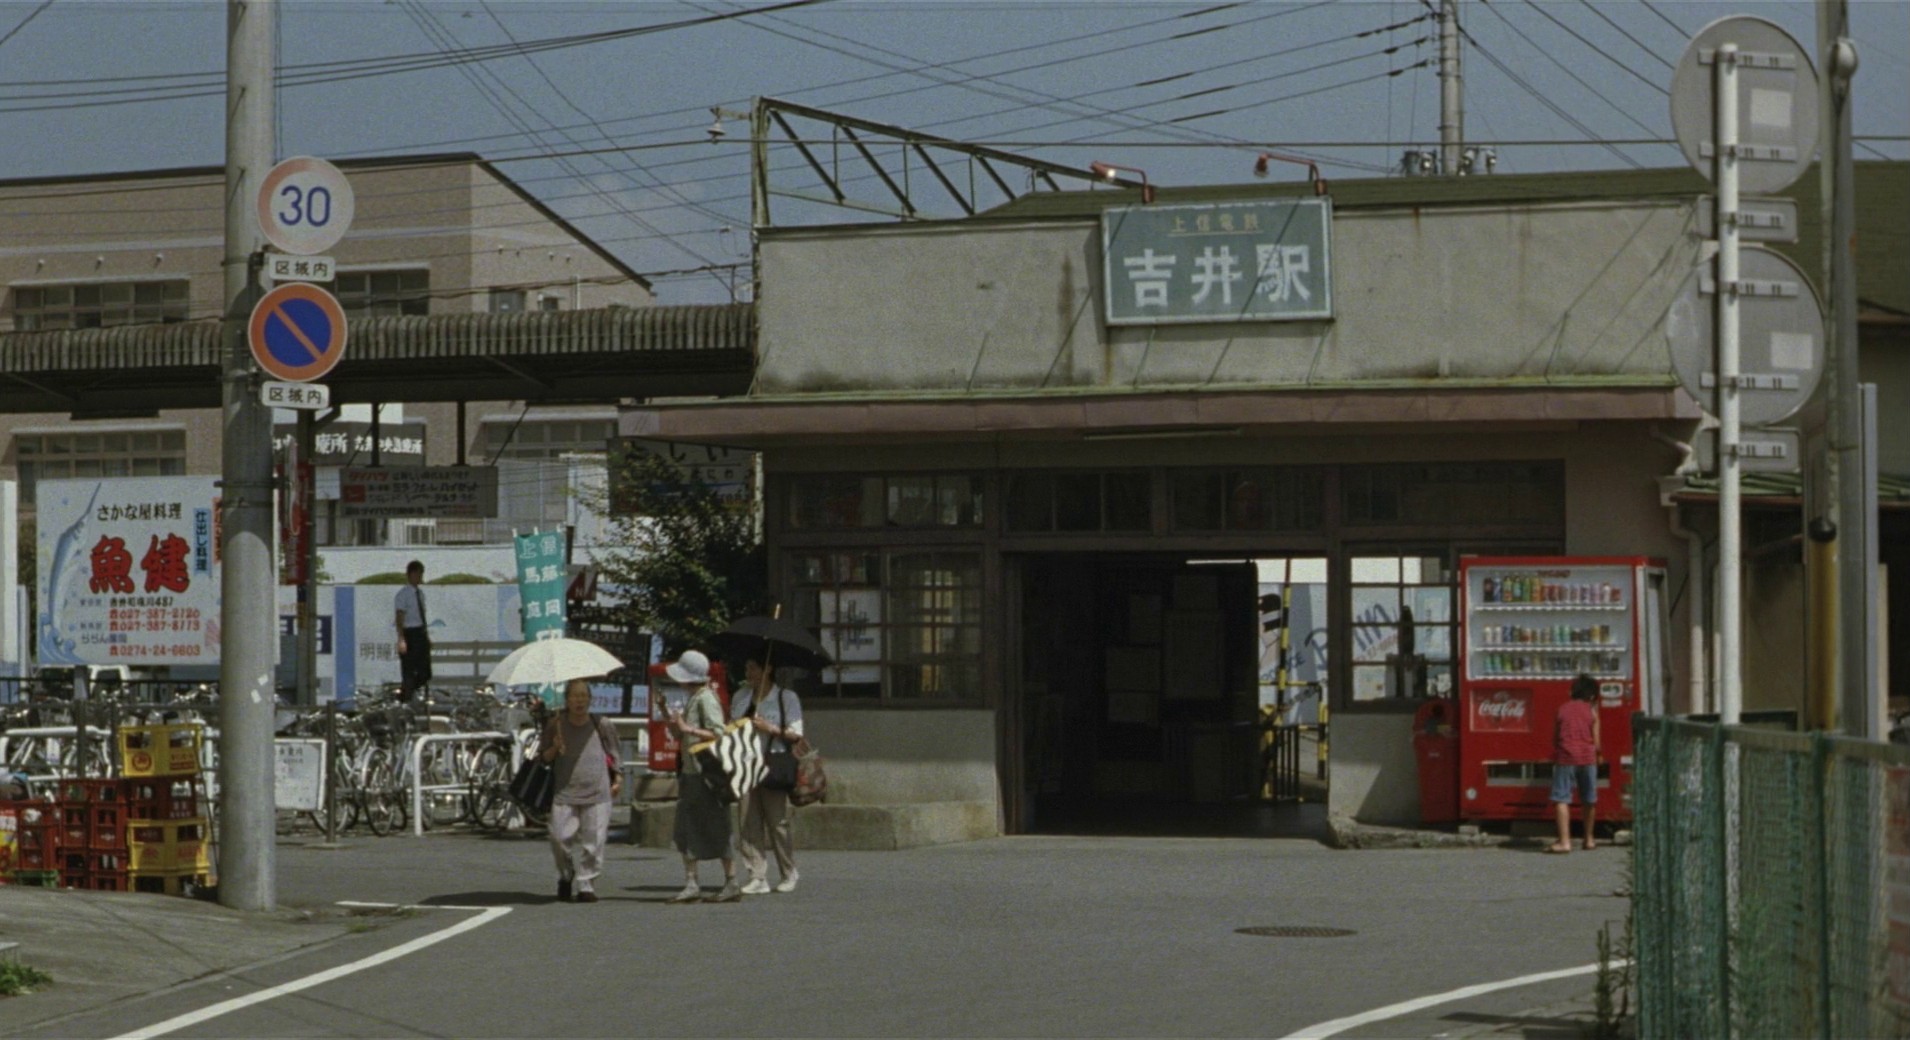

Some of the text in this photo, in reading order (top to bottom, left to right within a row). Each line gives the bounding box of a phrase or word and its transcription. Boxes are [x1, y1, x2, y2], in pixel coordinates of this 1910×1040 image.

[280, 185, 331, 227] 30
[275, 260, 329, 278] 区域内
[1123, 243, 1312, 308] 吉井駅
[269, 386, 323, 404] 区域内
[97, 502, 182, 521] さかな屋料理
[89, 532, 191, 594] 魚健
